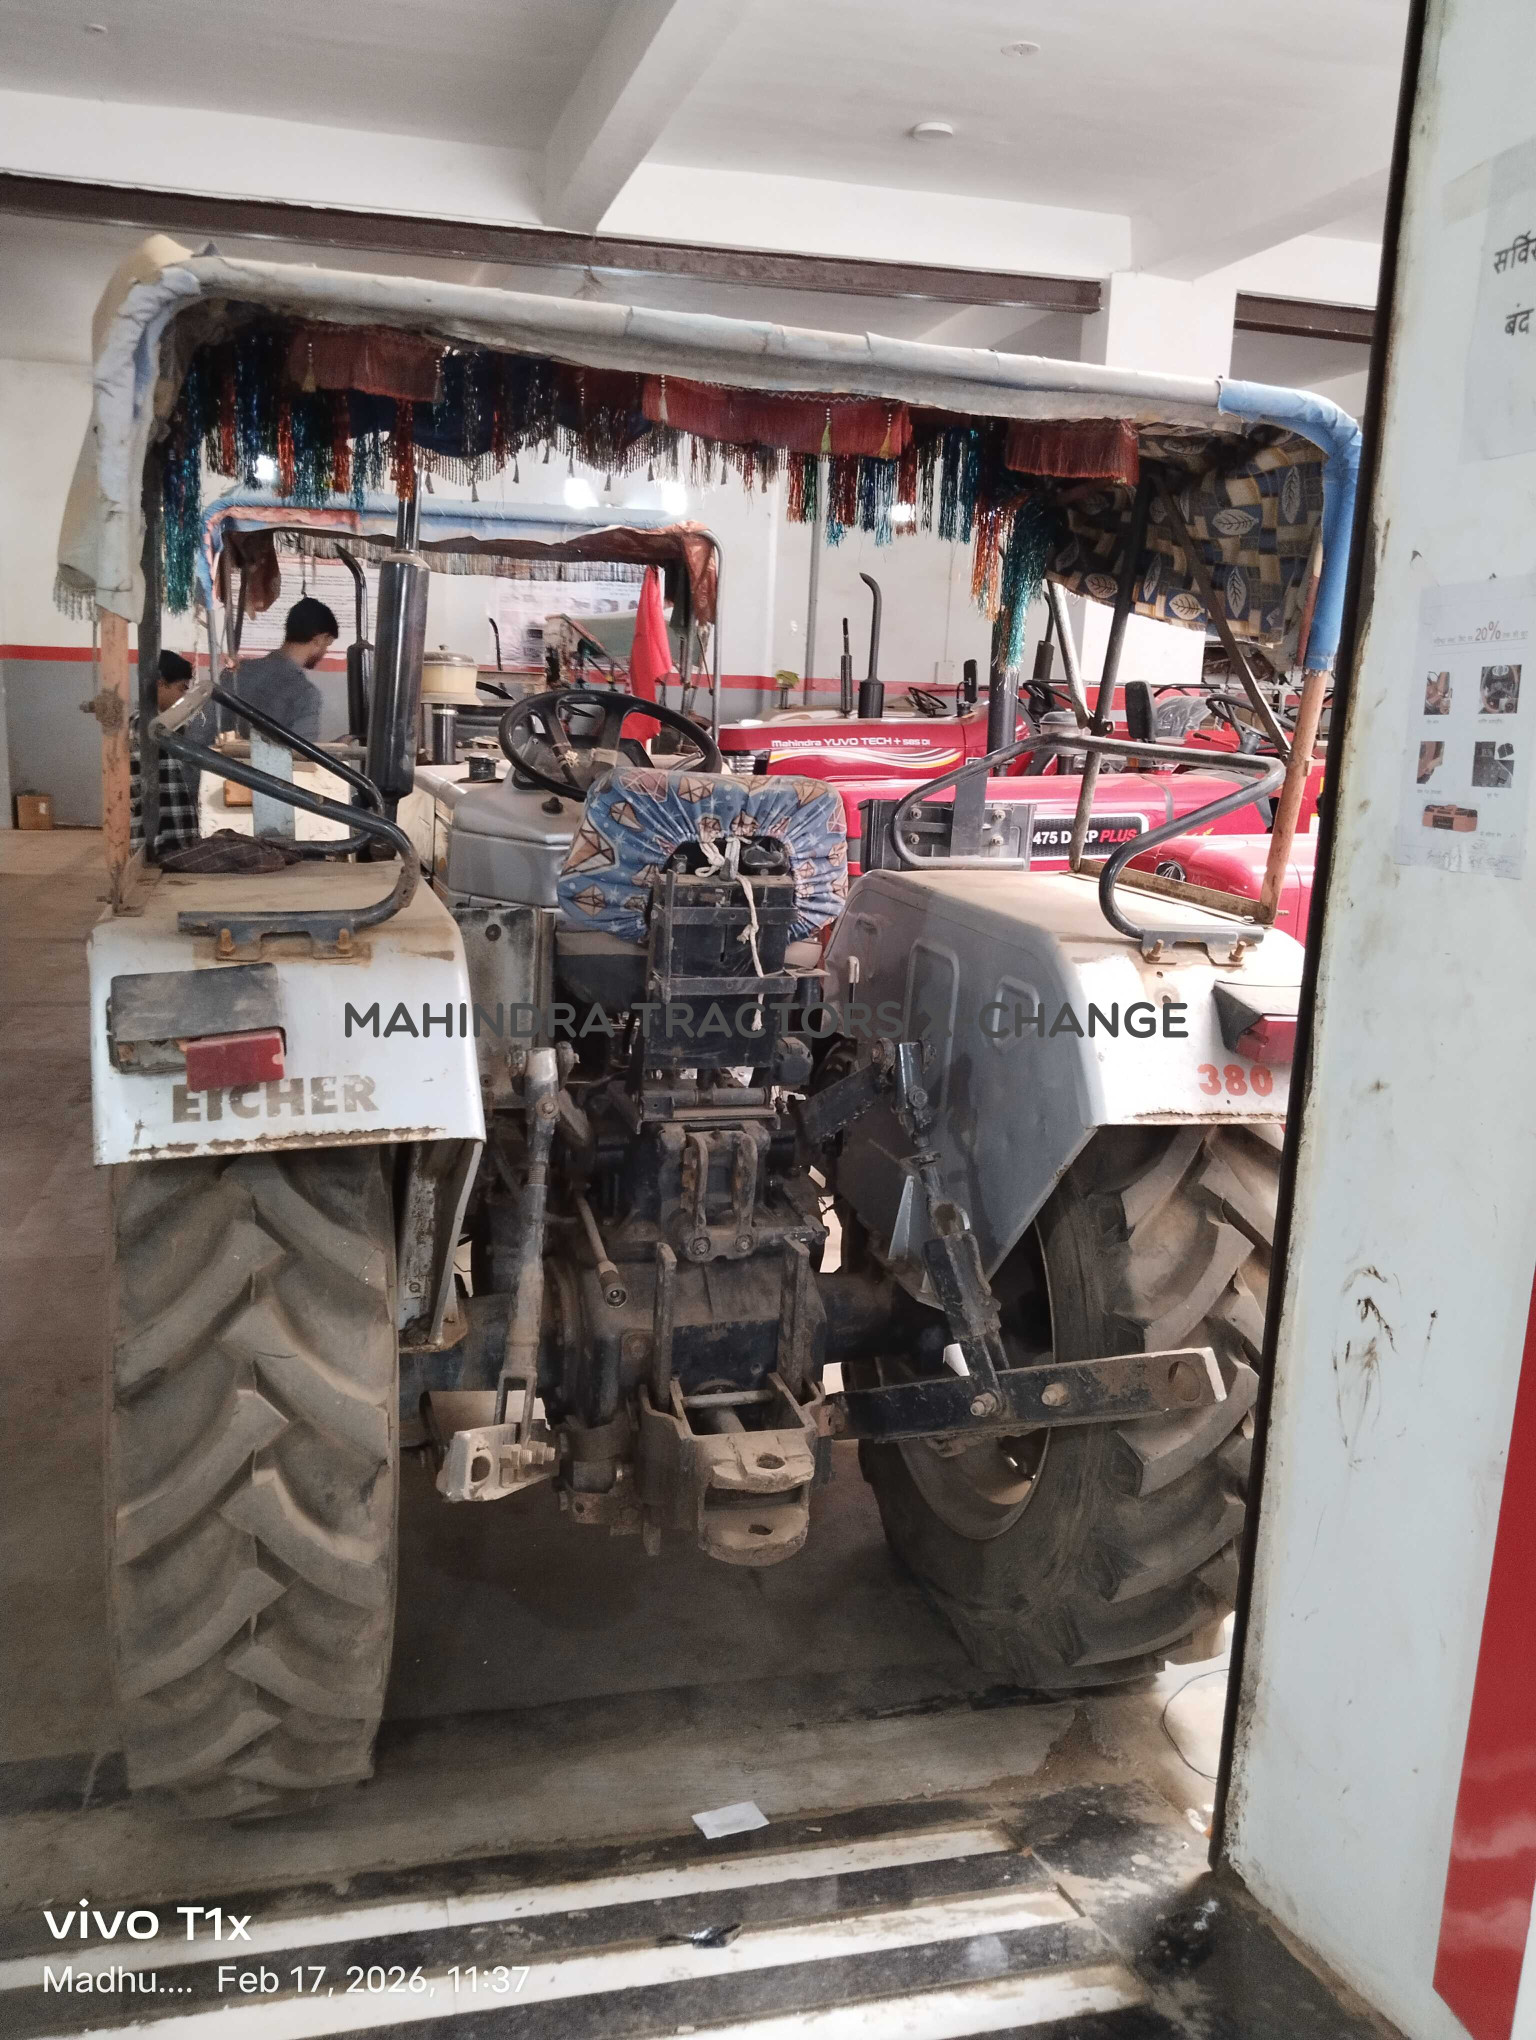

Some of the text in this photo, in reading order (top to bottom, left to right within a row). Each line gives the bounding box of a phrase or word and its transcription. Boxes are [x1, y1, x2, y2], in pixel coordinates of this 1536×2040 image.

[1494, 230, 1536, 274] सर्वि
[1475, 620, 1501, 641] 20%
[771, 739, 822, 748] Mahindra
[824, 738, 858, 746] YUVO
[861, 737, 892, 745] TECH
[1032, 831, 1058, 844] 475
[1060, 830, 1072, 844] D
[1099, 829, 1137, 843] PLUS
[1197, 1063, 1273, 1097] 380
[172, 1074, 380, 1124] EICHER
